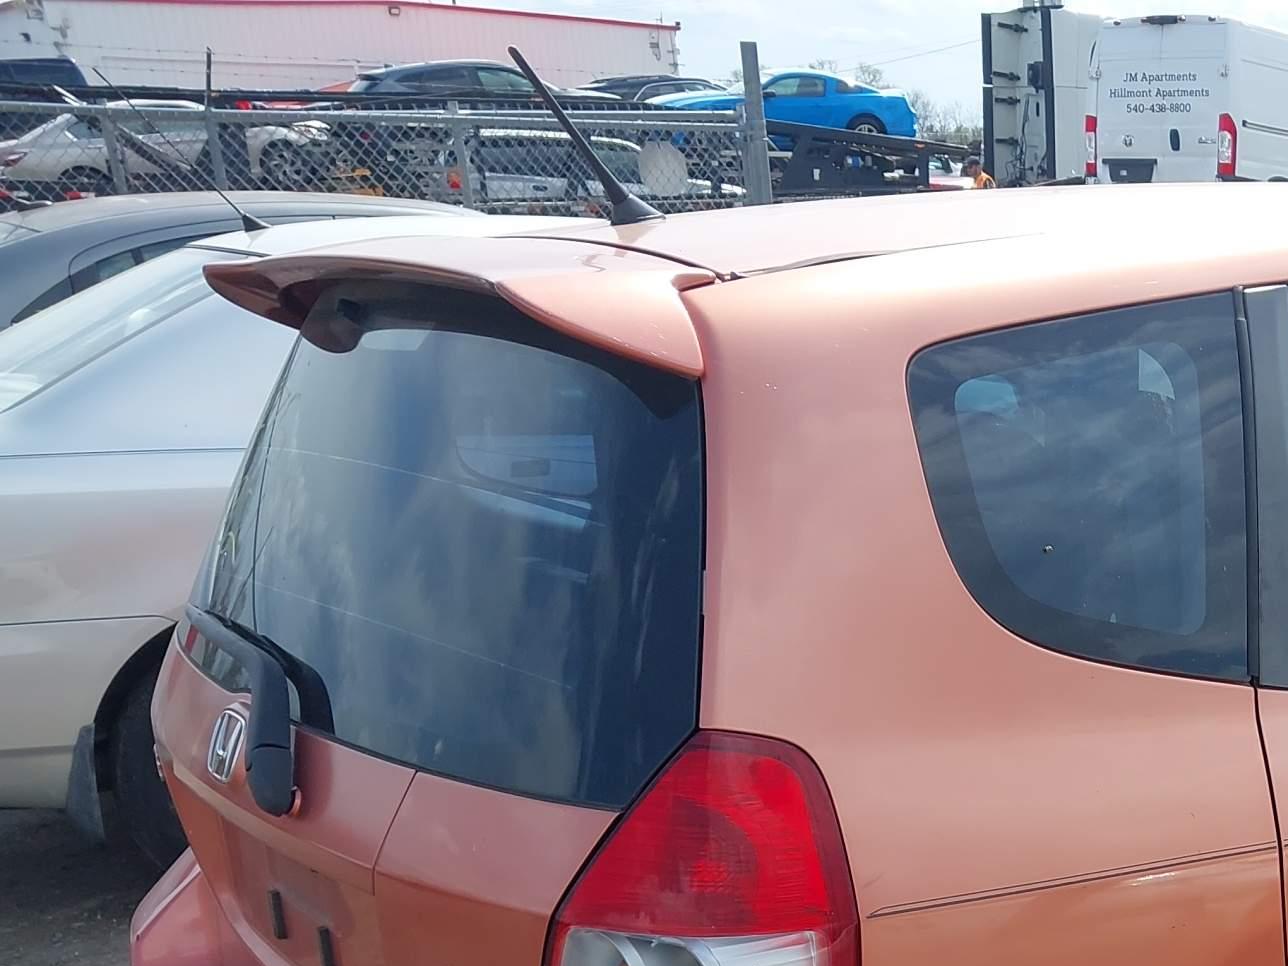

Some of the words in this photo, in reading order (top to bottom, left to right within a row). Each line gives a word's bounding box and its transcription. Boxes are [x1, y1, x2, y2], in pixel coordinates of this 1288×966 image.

[1123, 72, 1139, 82] JM
[1140, 72, 1197, 84] Apartments
[1109, 88, 1152, 98] Hillmont
[1155, 88, 1210, 100] Apartments
[1127, 103, 1191, 113] 540-438-8800
